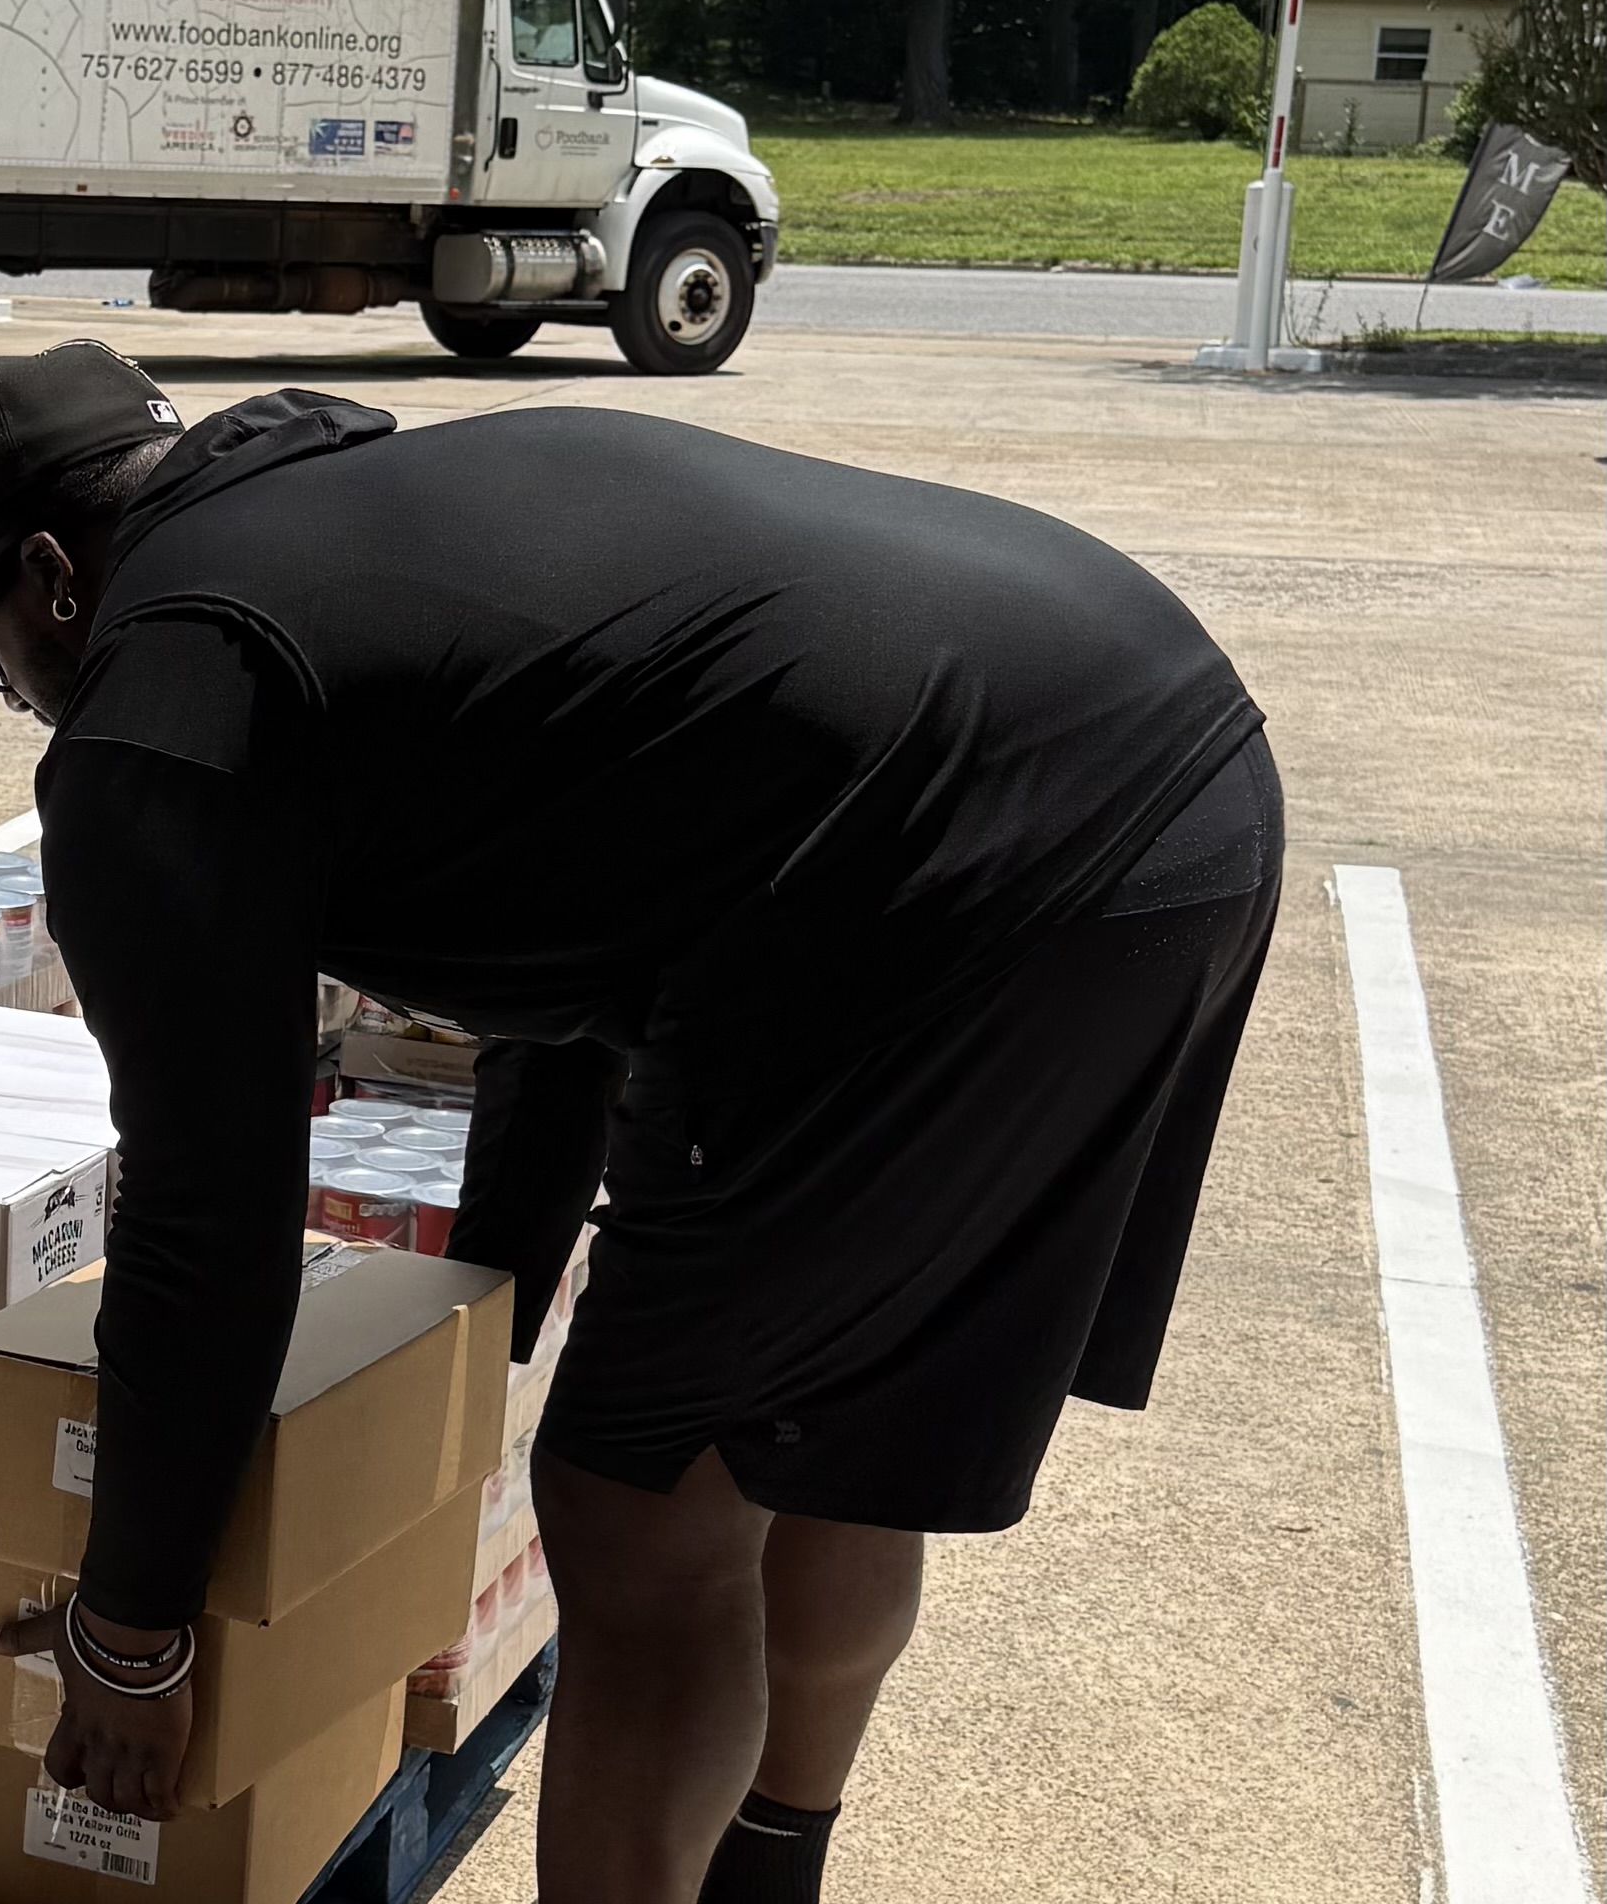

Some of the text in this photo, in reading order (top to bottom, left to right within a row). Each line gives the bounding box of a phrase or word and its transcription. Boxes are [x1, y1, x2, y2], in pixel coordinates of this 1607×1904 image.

[112, 20, 402, 59] www.foodbankonline.org
[45, 1243, 78, 1275] CHEESE
[45, 1808, 141, 1841] Quck Yellow Grits
[69, 1830, 97, 1847] 12/24
[99, 1841, 112, 1850] oz
